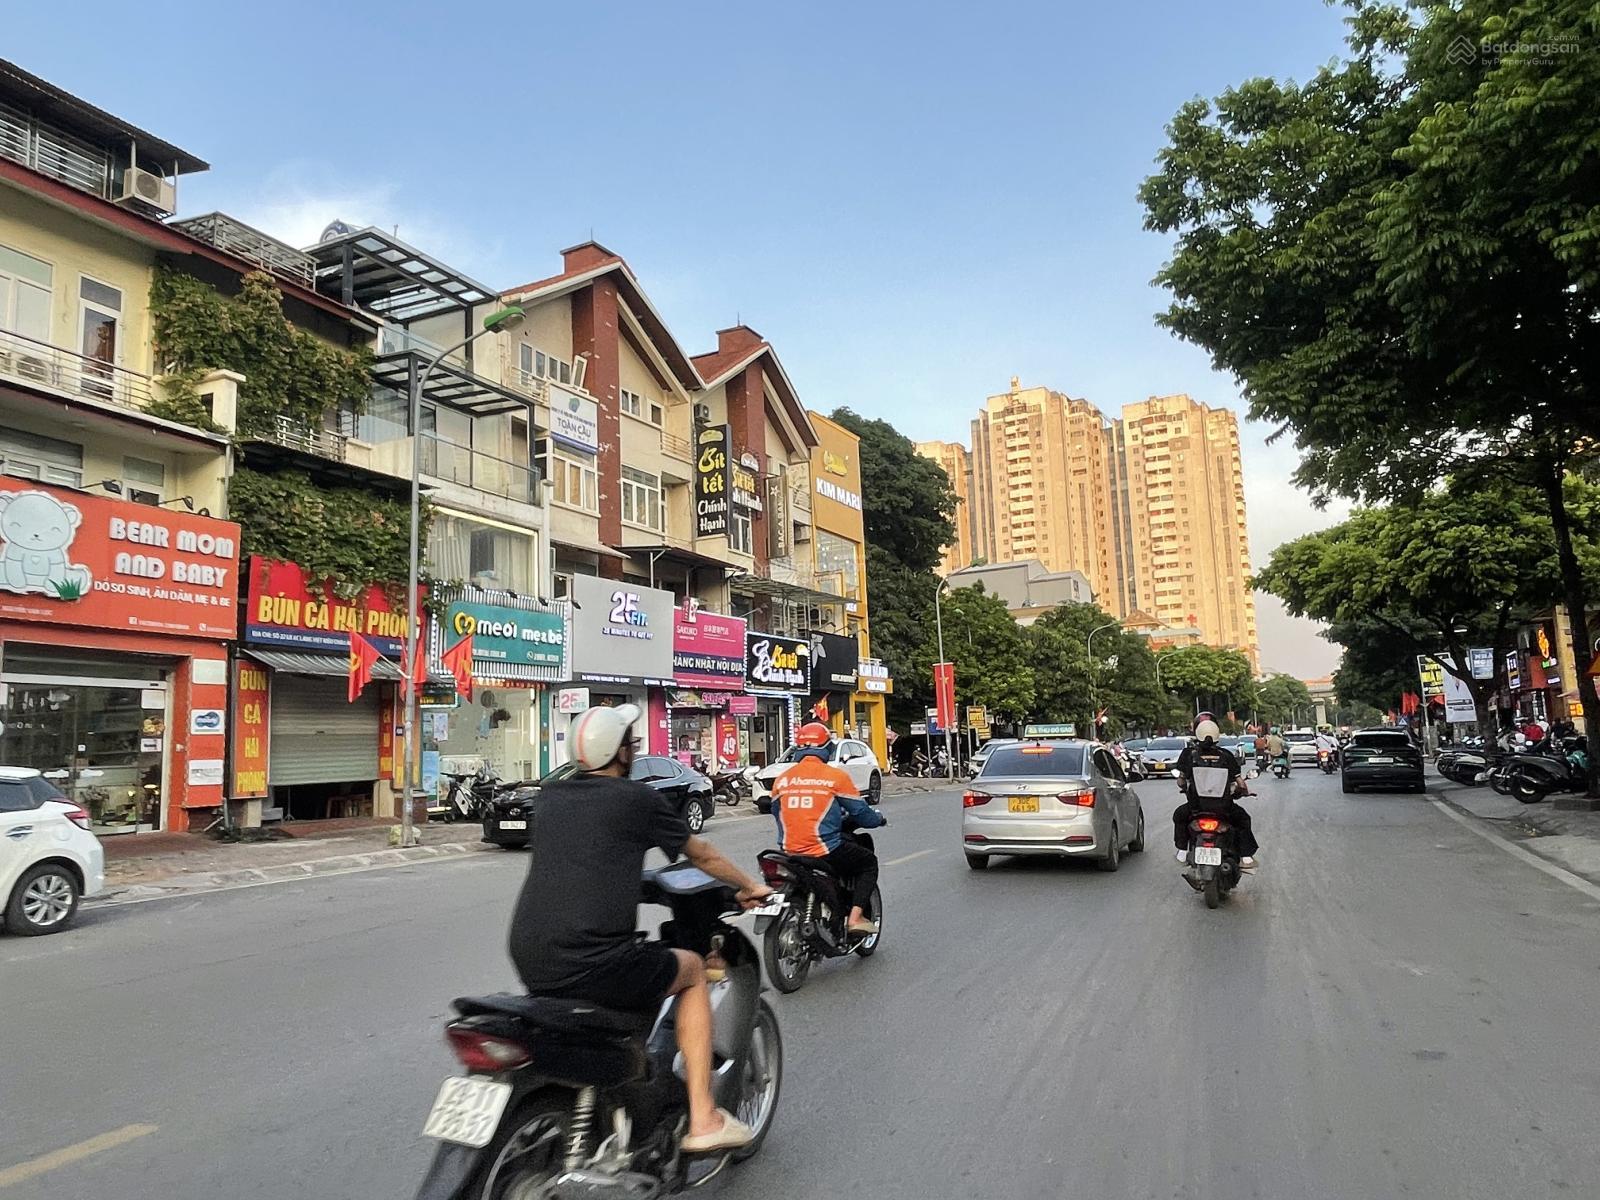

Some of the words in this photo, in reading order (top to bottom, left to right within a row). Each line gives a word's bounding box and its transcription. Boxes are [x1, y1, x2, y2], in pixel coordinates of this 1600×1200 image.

[702, 472, 724, 494] tết
[816, 477, 836, 500] KIM
[836, 487, 862, 511] MARU
[697, 497, 727, 516] Chính
[699, 515, 726, 533] Hạnh
[109, 517, 169, 548] BEAR
[176, 530, 234, 558] MOM
[114, 552, 166, 579] AND
[172, 561, 228, 588] BABY
[258, 592, 301, 626] BÚN
[304, 598, 329, 630] CÁ
[695, 656, 716, 673] NHẬT
[716, 657, 730, 675] NỘI
[789, 776, 836, 788] Ahamove
